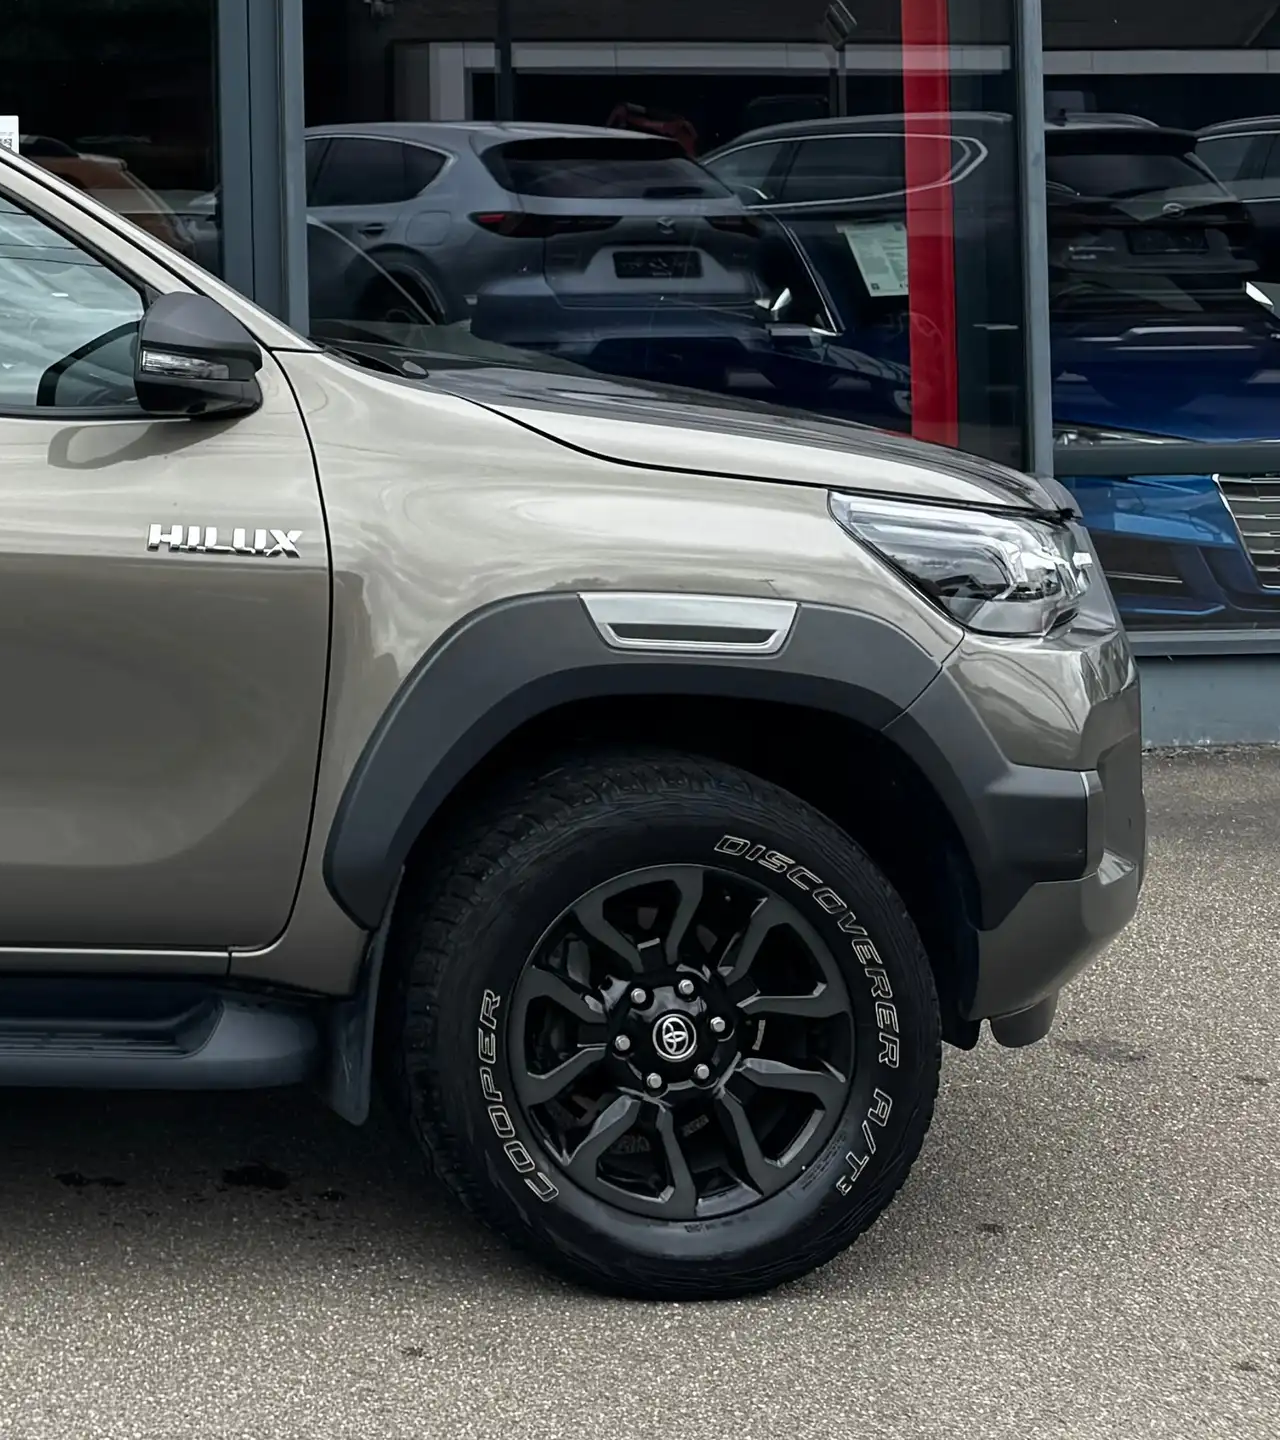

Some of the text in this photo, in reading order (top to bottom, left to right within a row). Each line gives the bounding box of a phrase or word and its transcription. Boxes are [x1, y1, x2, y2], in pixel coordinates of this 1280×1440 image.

[147, 523, 303, 558] HILUX
[713, 834, 900, 1068] DISCOVERER
[478, 989, 560, 1203] COOPER
